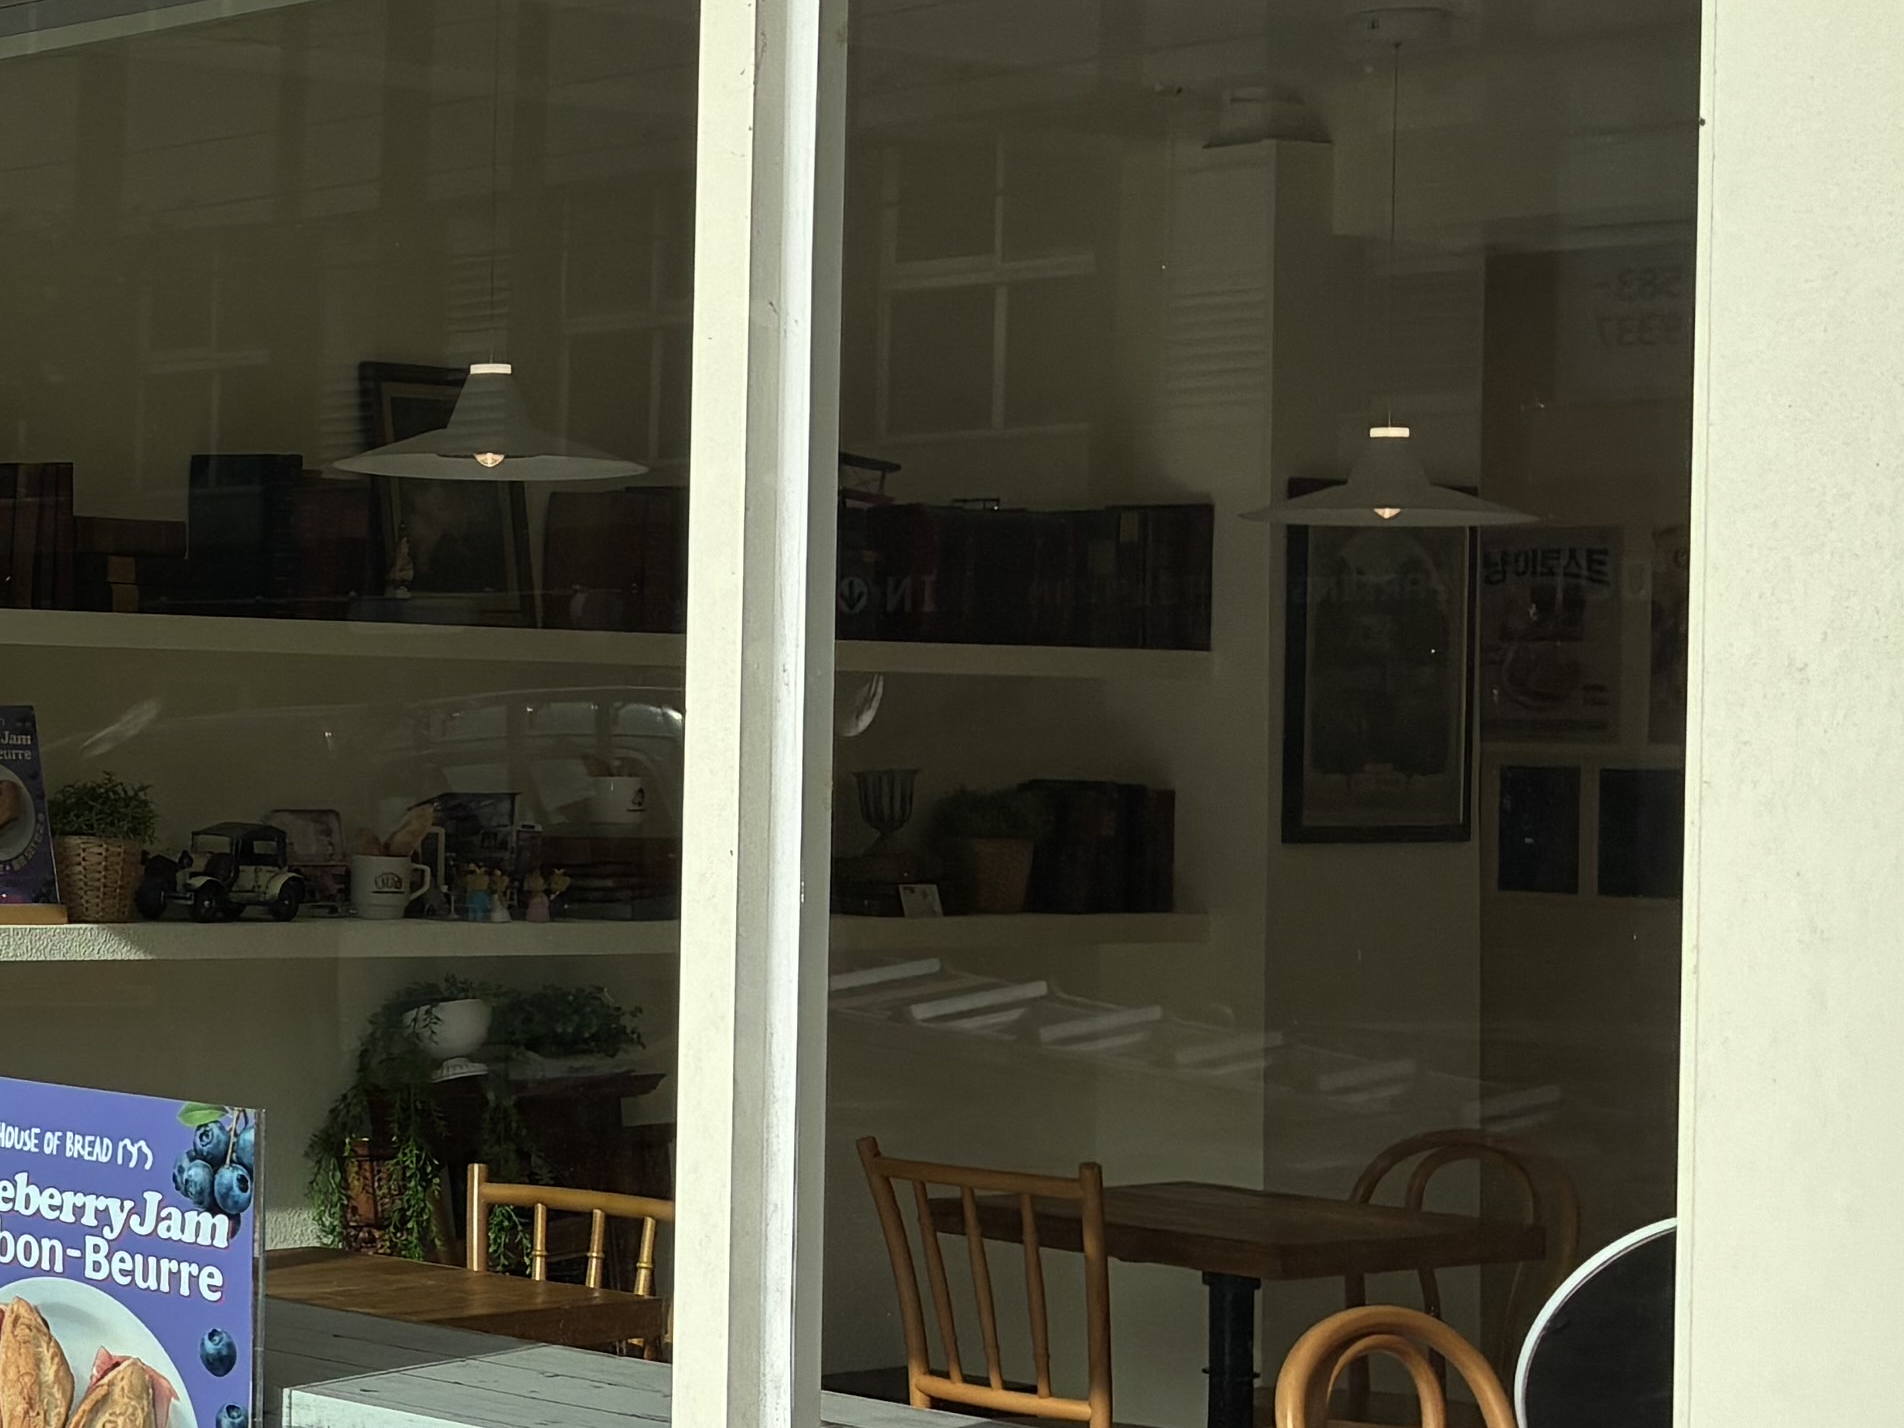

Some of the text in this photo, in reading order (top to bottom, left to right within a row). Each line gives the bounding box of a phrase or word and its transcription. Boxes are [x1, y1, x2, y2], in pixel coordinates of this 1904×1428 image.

[0, 732, 32, 746] Jam
[43, 1130, 63, 1156] OF
[65, 1131, 113, 1164] BREAD
[129, 1190, 230, 1250] Jam
